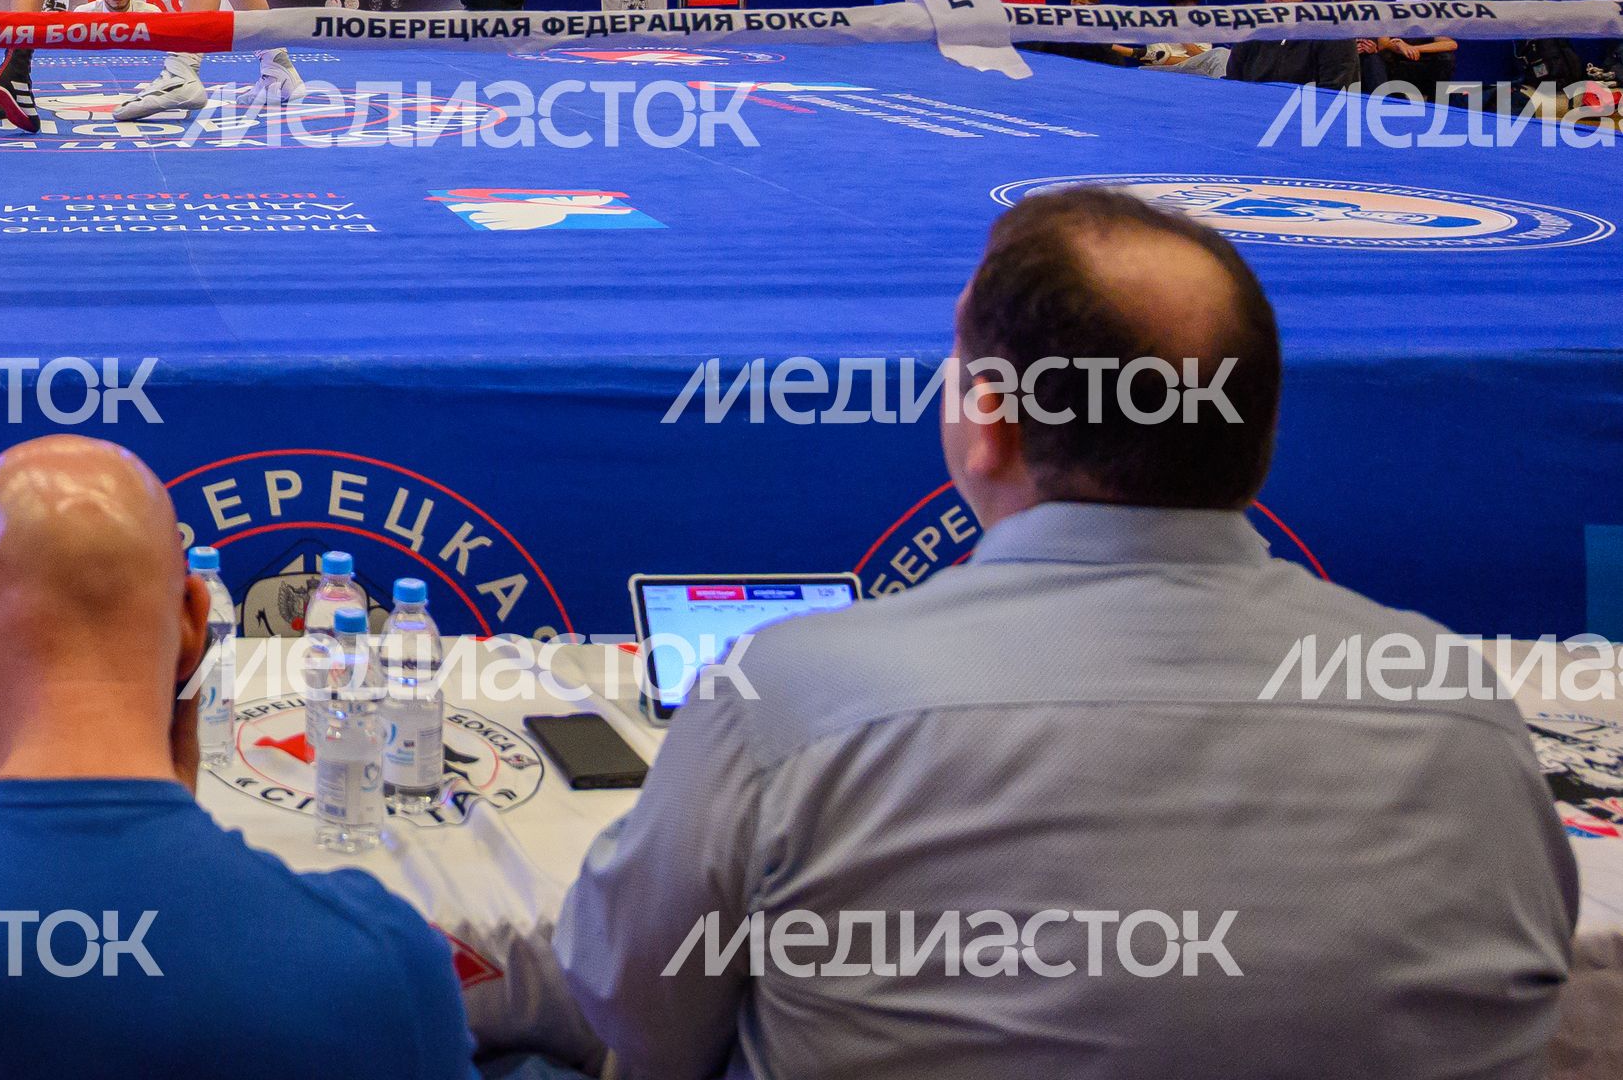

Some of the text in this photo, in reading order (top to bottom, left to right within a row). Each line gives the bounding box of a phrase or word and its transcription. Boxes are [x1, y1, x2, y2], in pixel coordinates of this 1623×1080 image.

[312, 9, 850, 41] ЛЮБЕРЕЦКАЯ ФЕДЕРАЦИЯ БОКСА
[1187, 1, 1498, 30] ФЕДЕРАЦИЯ БОКСА
[44, 22, 150, 44] БОКСА
[65, 201, 356, 212] Адриана
[447, 714, 514, 751] БОКСА
